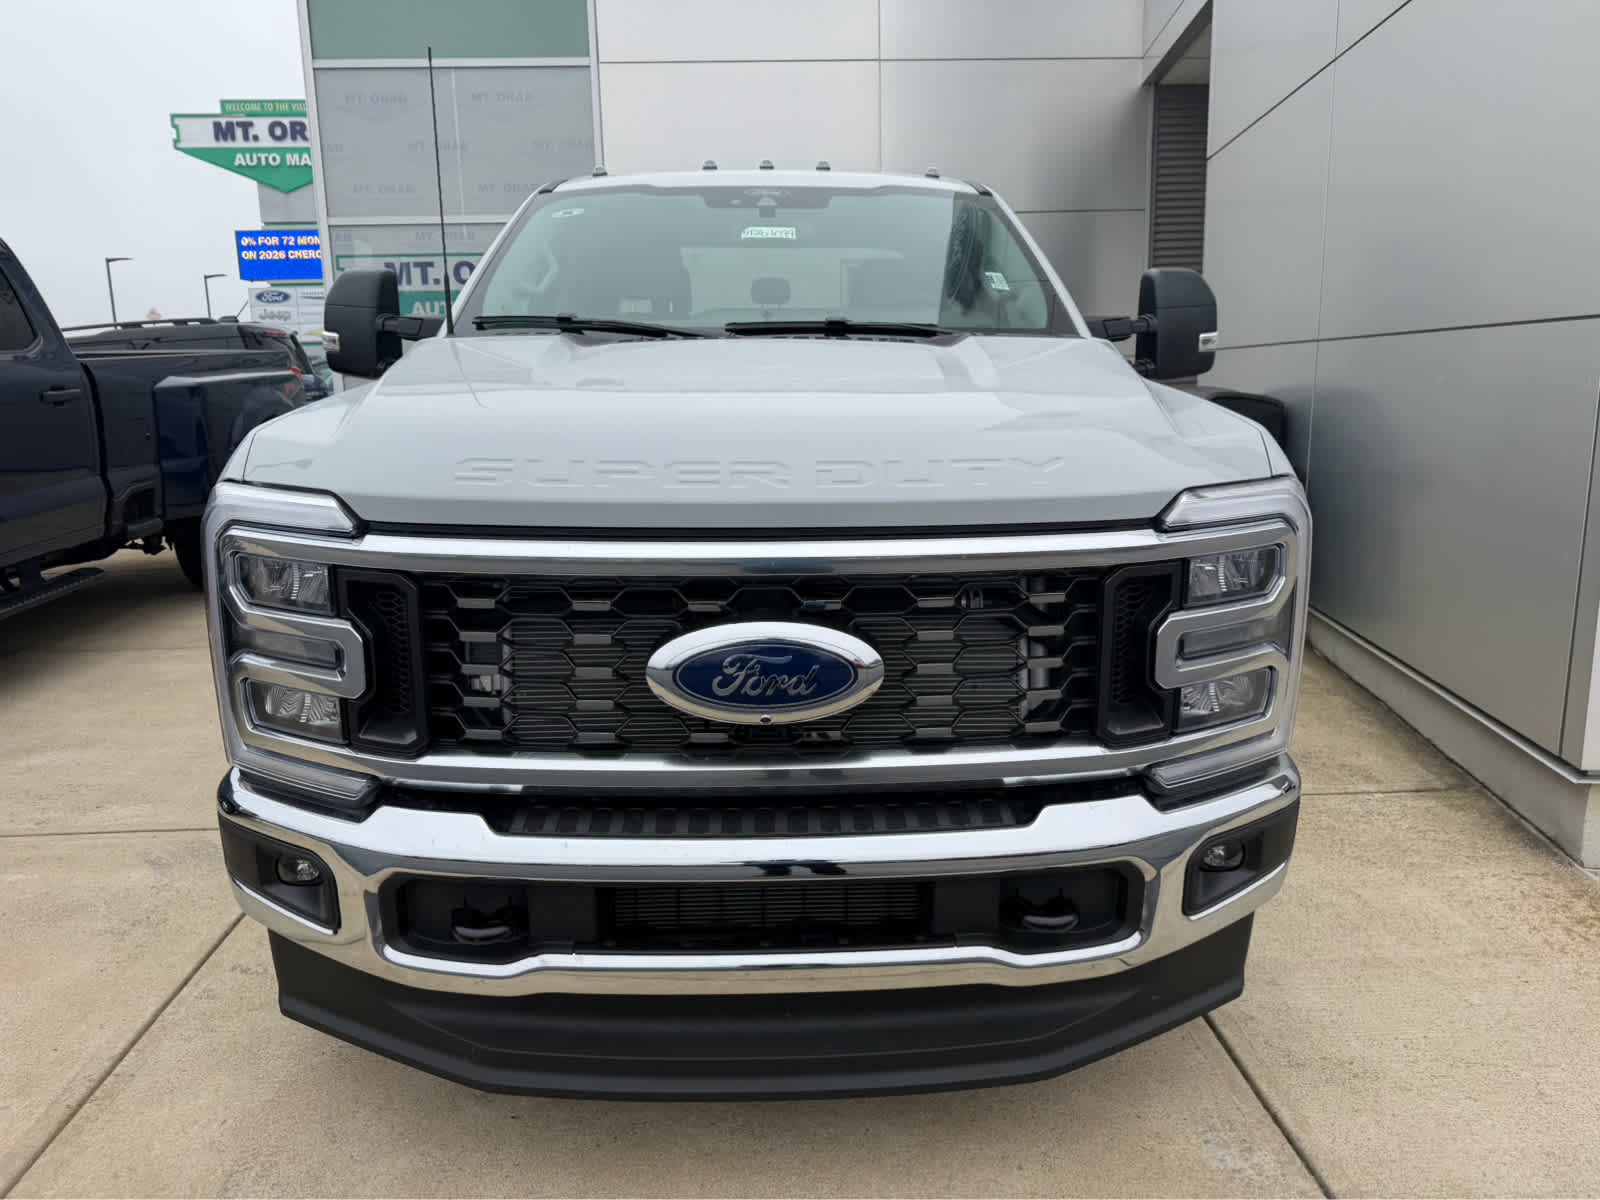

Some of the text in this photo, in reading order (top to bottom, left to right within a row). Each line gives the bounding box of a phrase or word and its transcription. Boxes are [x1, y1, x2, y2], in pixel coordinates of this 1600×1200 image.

[225, 102, 261, 113] WELCOME
[263, 102, 274, 113] TO
[275, 102, 290, 113] THE
[213, 120, 309, 142] MT. OR
[234, 153, 312, 167] AUTO MA
[241, 235, 320, 247] 0% FOR 72 MON
[241, 250, 257, 260] ON
[259, 250, 287, 260] 2026
[454, 455, 1065, 489] SUPER DUTY
[711, 653, 820, 696] Ford
